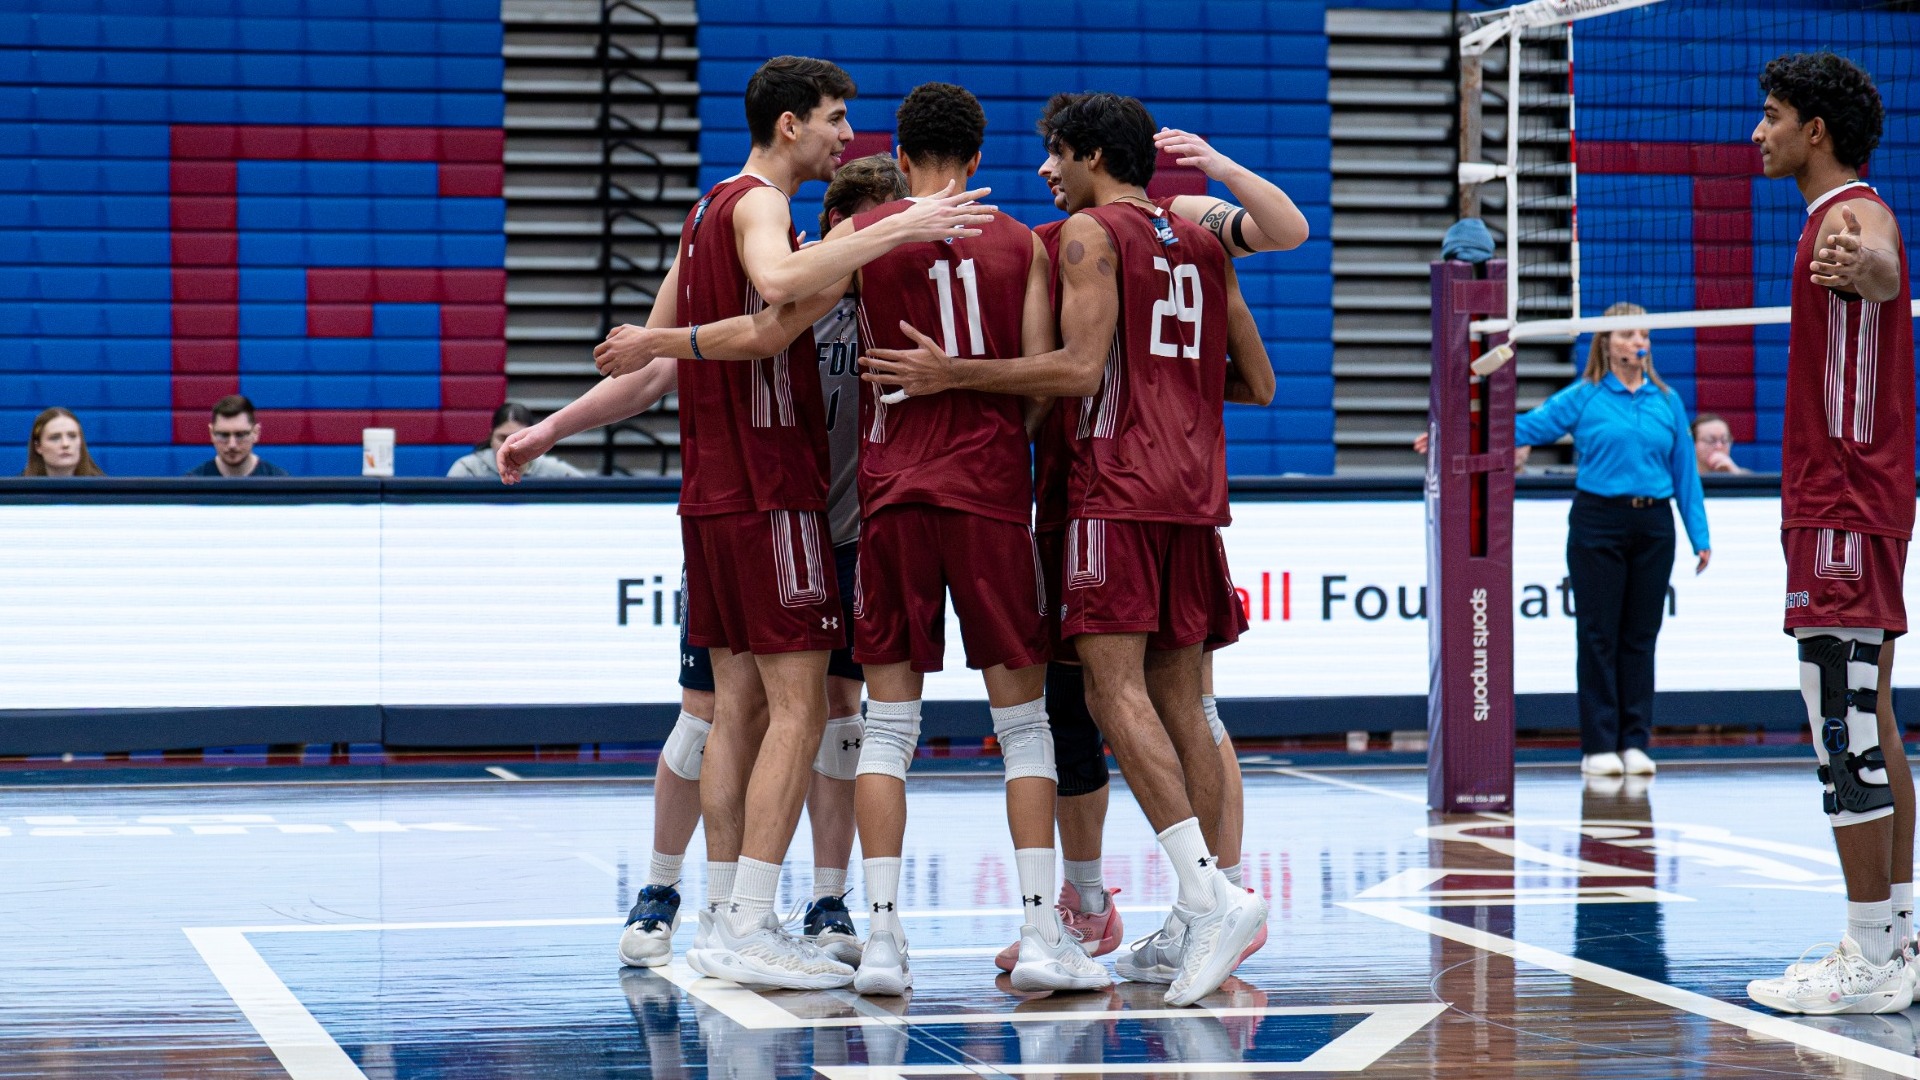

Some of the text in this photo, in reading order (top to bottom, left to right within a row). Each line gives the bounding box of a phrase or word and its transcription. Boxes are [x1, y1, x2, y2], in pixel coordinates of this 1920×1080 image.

[170, 126, 506, 444] G
[928, 258, 985, 358] 11
[1150, 255, 1204, 360] 29
[1469, 588, 1491, 722] sports imports
